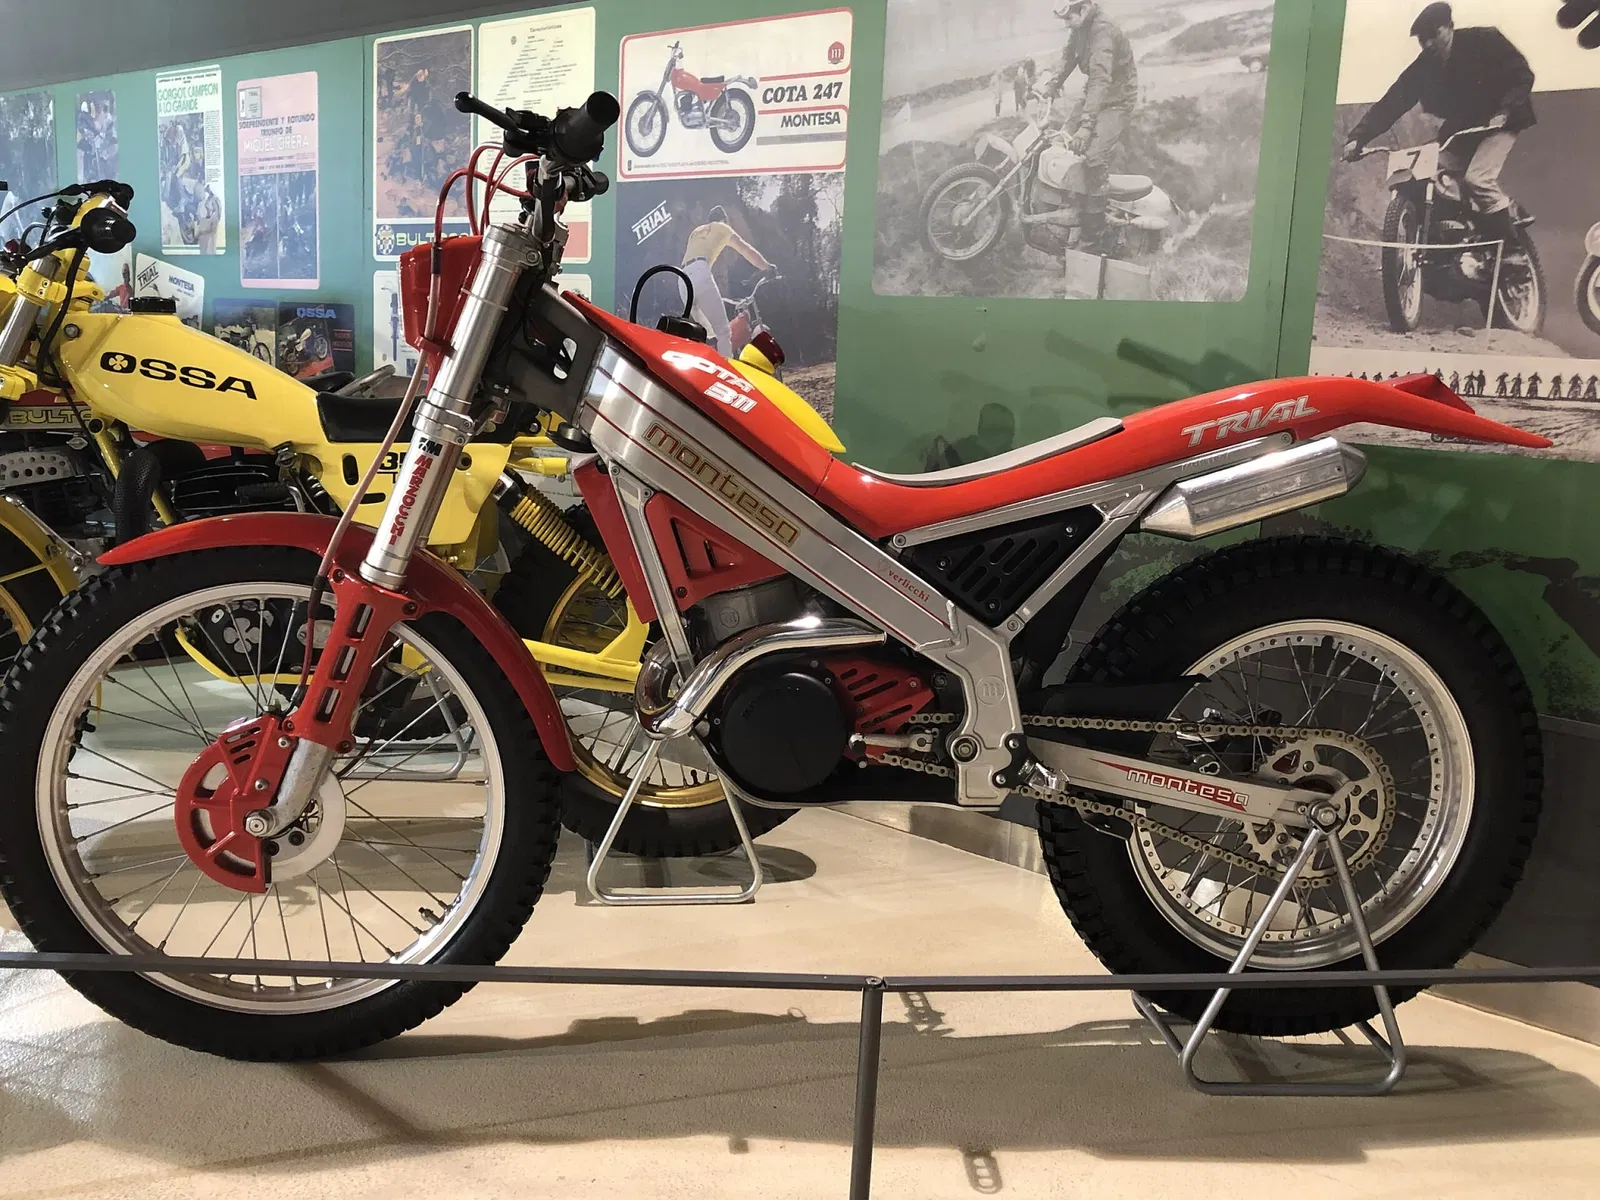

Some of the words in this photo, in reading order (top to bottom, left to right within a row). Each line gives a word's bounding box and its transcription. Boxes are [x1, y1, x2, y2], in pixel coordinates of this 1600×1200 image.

[762, 85, 808, 104] COTA
[813, 82, 843, 100] 247
[781, 112, 841, 128] MONTESA
[243, 138, 275, 153] MIGUEL
[632, 206, 671, 240] TRIAL
[138, 265, 158, 287] TRIAL
[296, 307, 337, 319] OSSA
[100, 351, 257, 400] OSSA
[703, 381, 757, 413] 311
[1181, 395, 1320, 447] TRIAL
[646, 422, 799, 544] montesa
[889, 570, 930, 602] verlicchi
[1126, 769, 1249, 806] montesa
